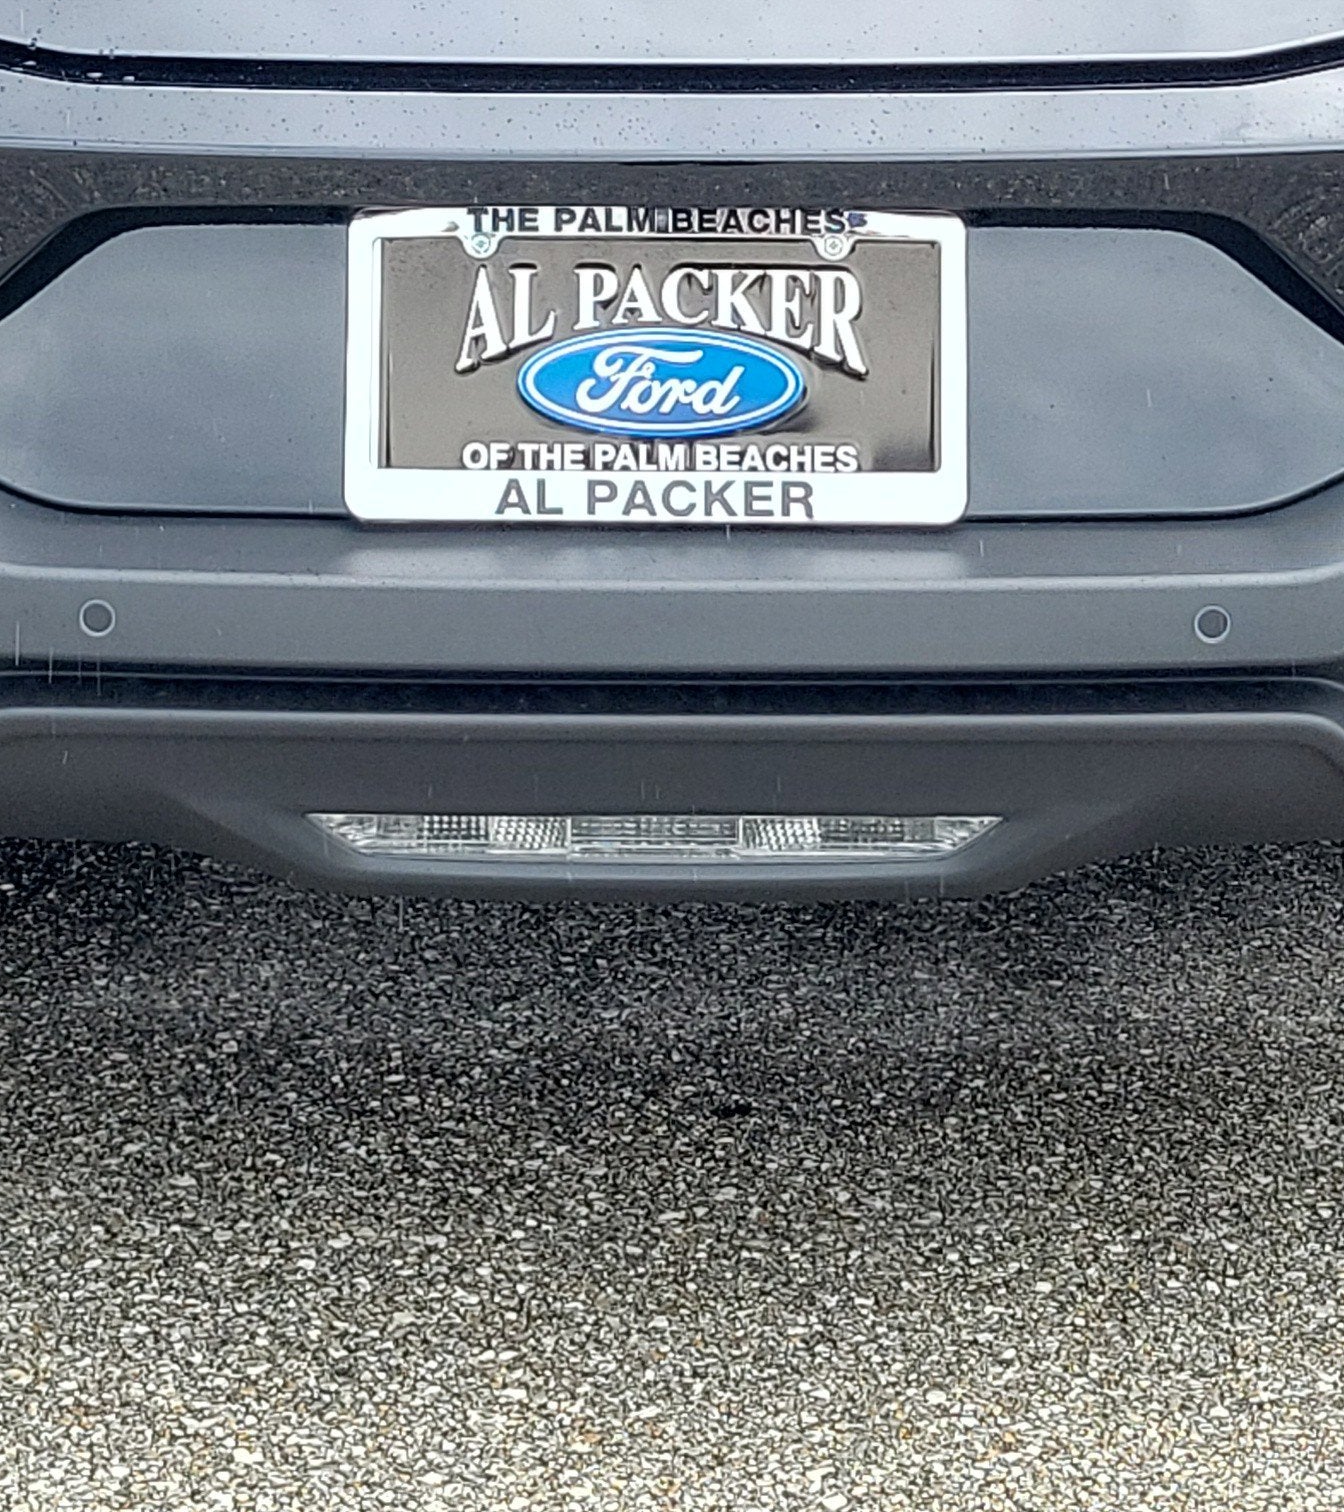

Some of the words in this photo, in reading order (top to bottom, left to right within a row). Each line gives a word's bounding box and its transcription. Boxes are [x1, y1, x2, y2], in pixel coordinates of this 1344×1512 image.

[466, 207, 540, 233] THE
[555, 207, 657, 233] PALM
[669, 208, 846, 235] BEACHES
[455, 263, 556, 374] AL
[574, 263, 869, 378] PACKER
[576, 345, 747, 417] Ford
[462, 442, 514, 472] OF
[520, 443, 586, 472] THE
[594, 444, 688, 472] PALM
[696, 444, 858, 473] BEACHES
[494, 478, 564, 517] AL
[586, 479, 815, 519] PACKER
